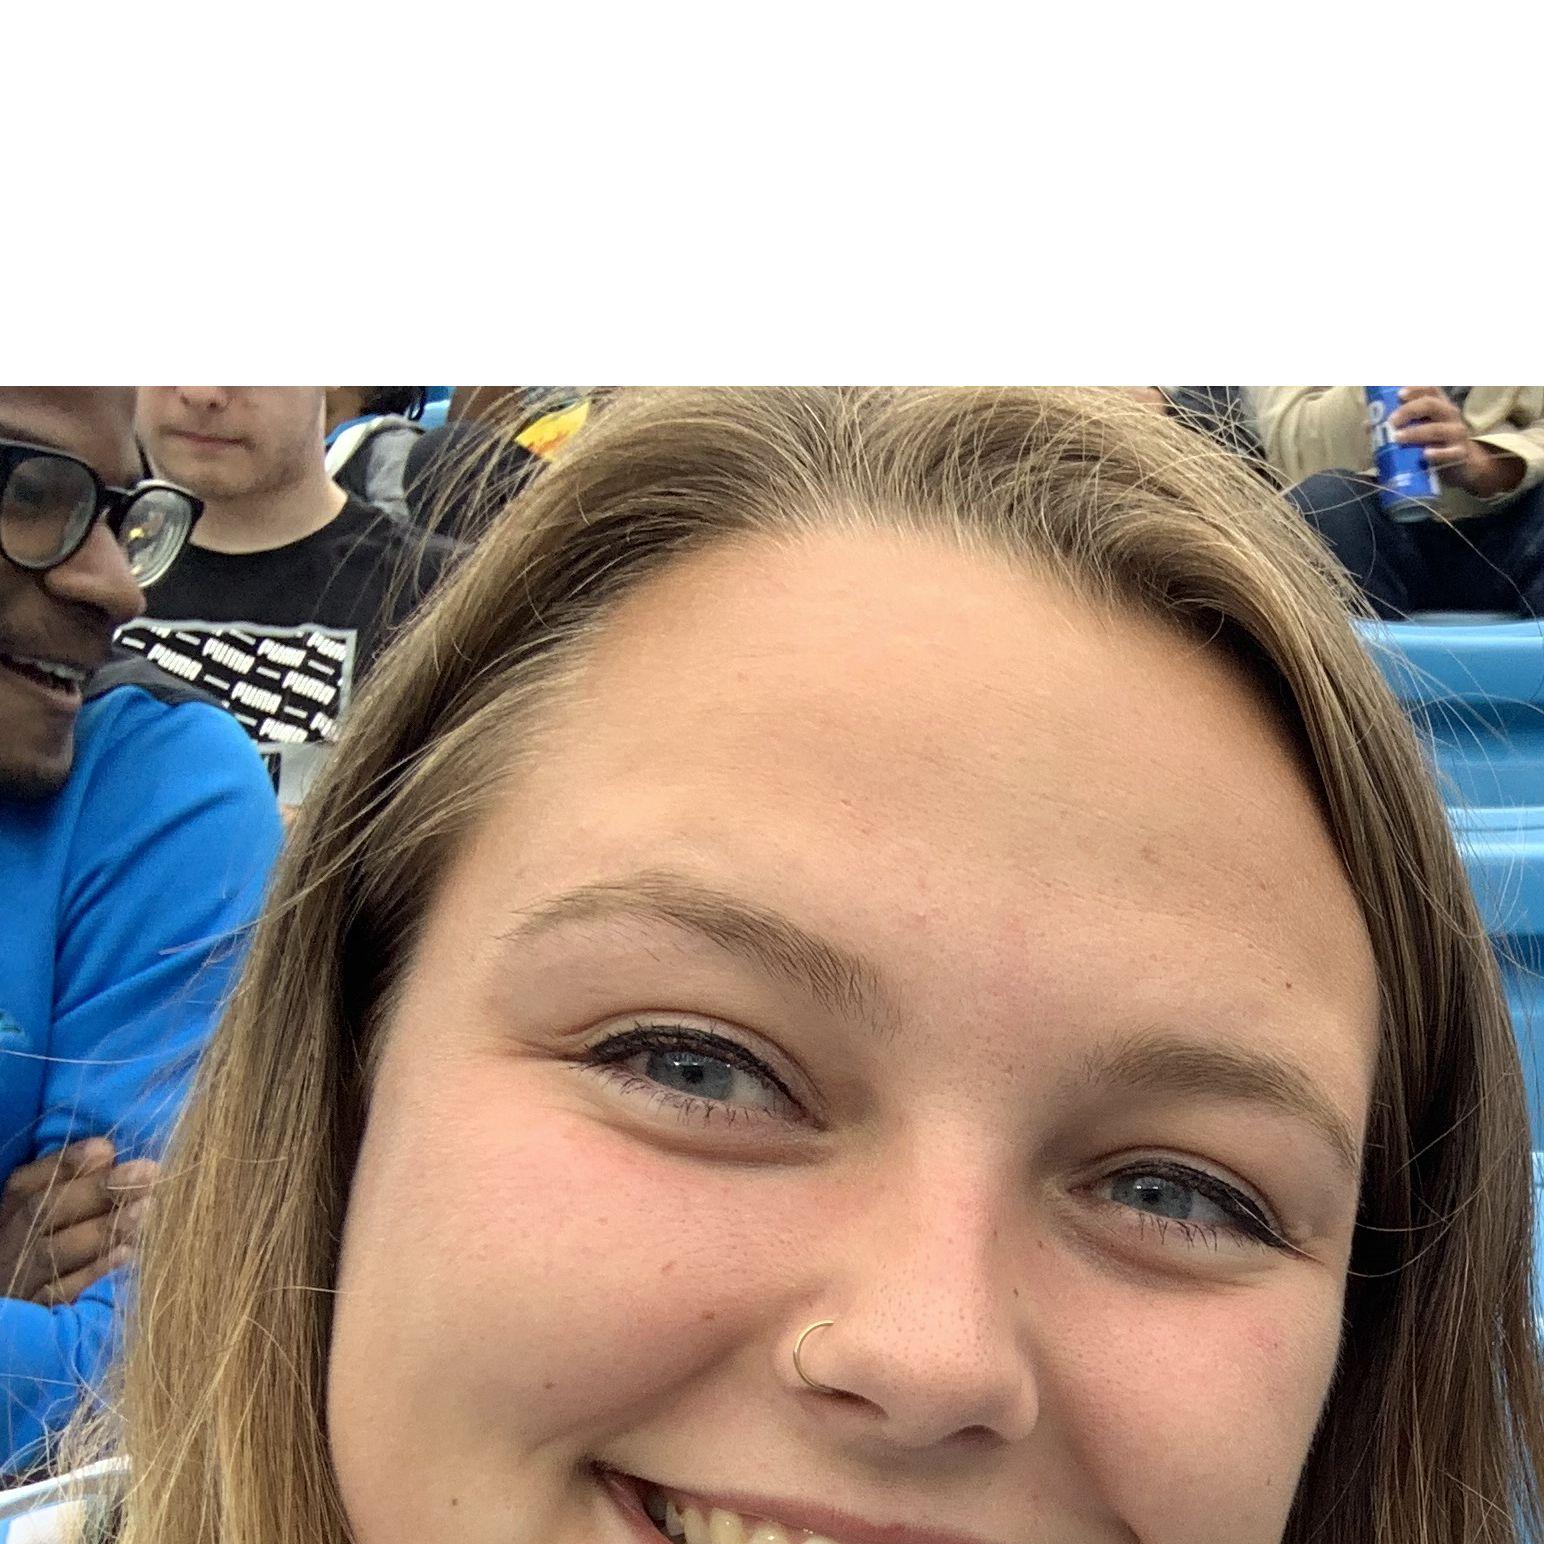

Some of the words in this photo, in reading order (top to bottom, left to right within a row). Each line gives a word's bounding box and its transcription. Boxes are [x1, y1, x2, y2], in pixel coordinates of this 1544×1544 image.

[146, 643, 203, 682] PUMA
[230, 680, 283, 715] PUMA
[202, 637, 256, 675] PUMA
[281, 670, 337, 706] PUMA
[256, 637, 308, 668] PUMA
